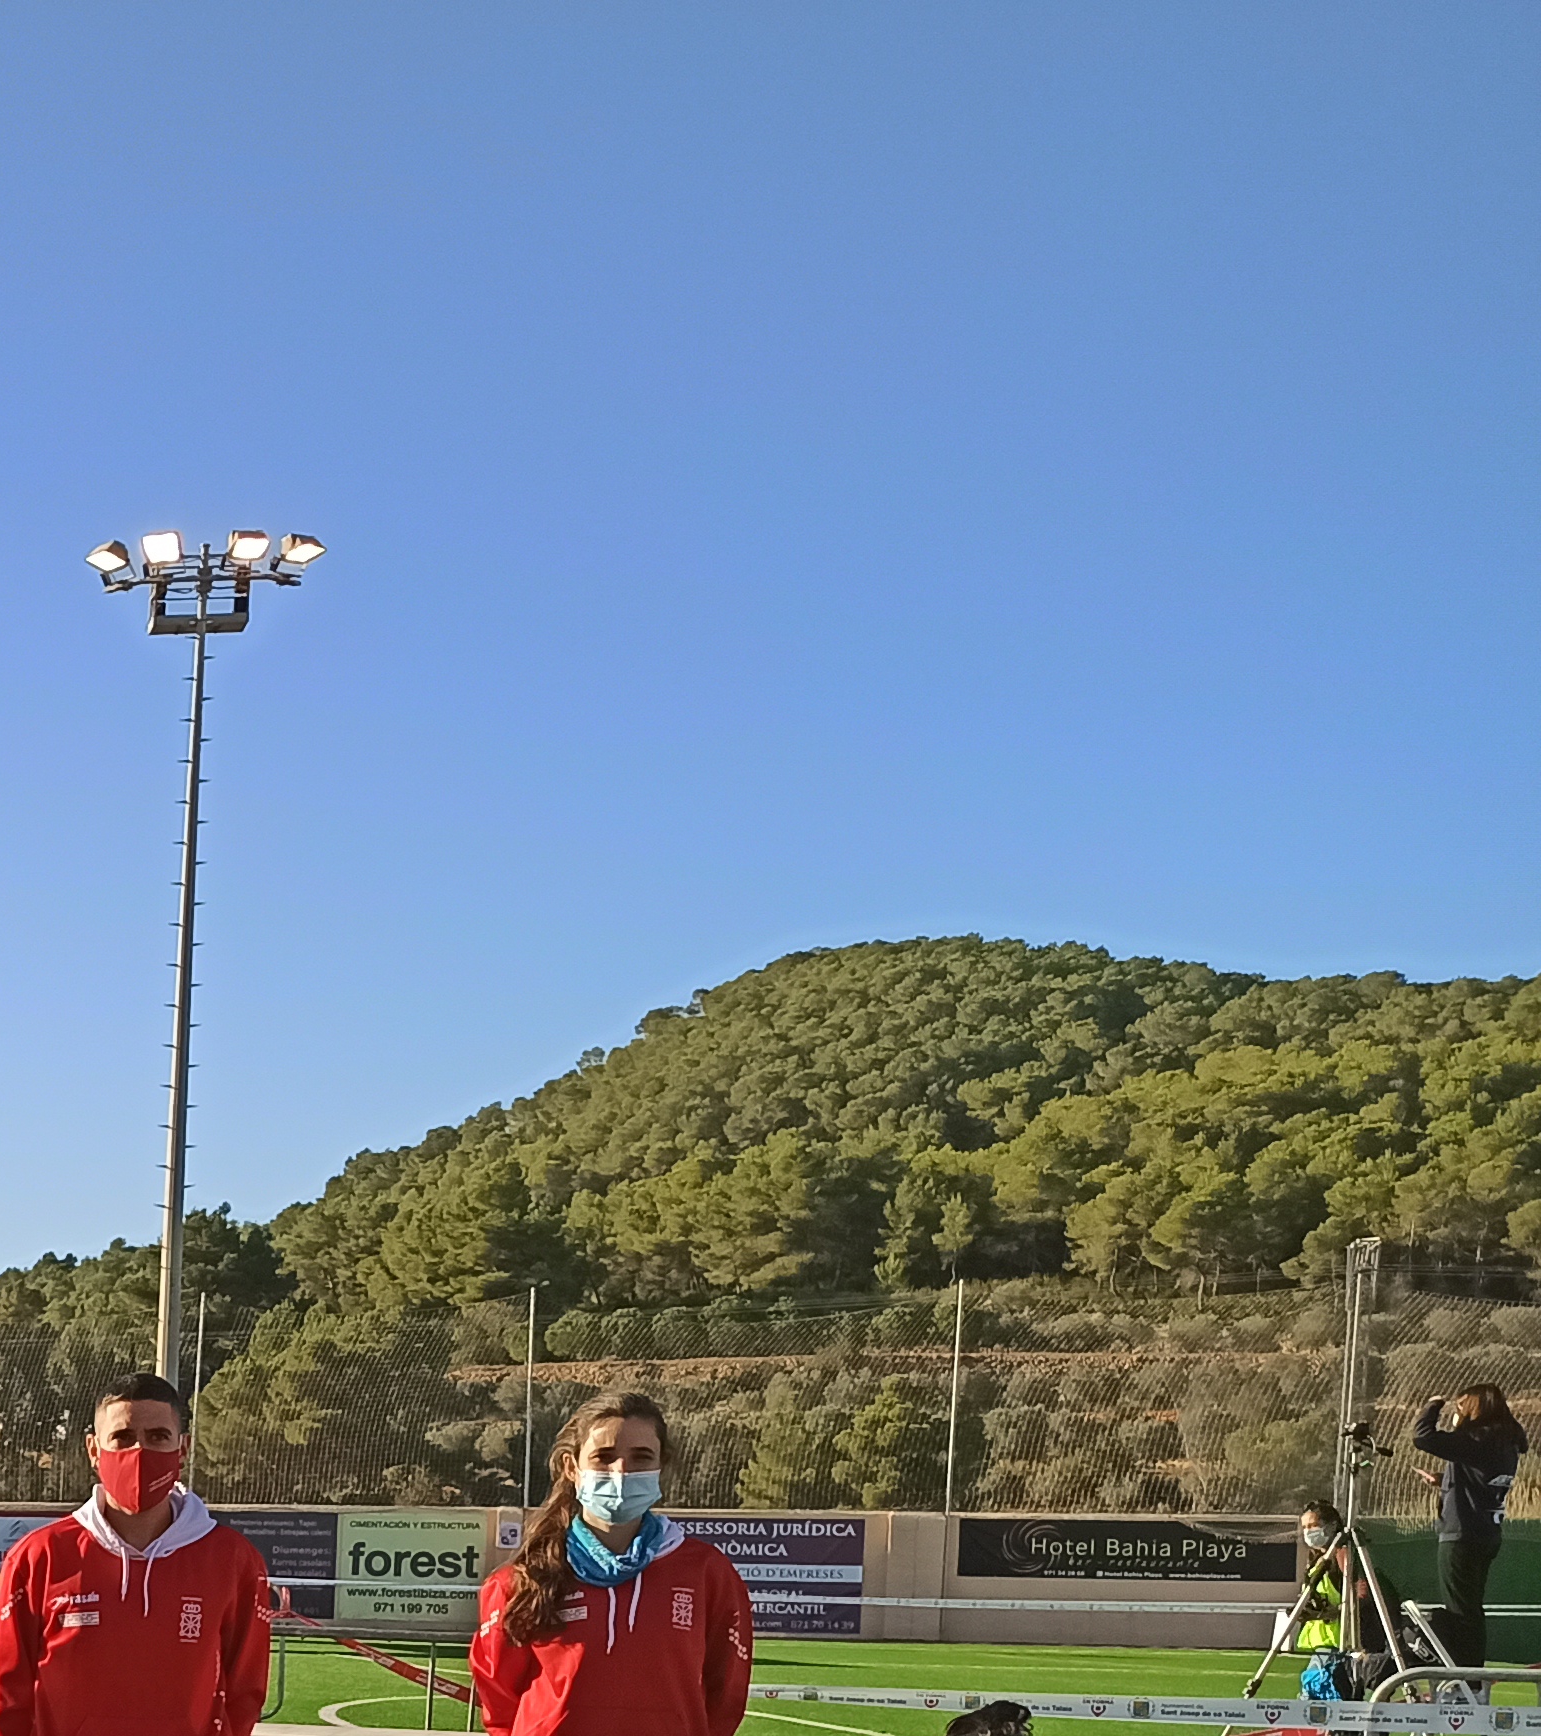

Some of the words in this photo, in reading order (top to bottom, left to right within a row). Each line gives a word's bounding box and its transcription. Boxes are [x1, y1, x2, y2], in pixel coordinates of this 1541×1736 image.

[349, 1520, 411, 1529] CIMENTACIÓN
[412, 1521, 420, 1529] Y
[420, 1521, 481, 1530] ESTRUCTURA
[771, 1520, 857, 1539] JURÍDICA
[1030, 1537, 1096, 1557] Hotel
[1105, 1537, 1172, 1557] Bahia
[1182, 1538, 1247, 1563] Playa
[347, 1541, 480, 1579] forest
[346, 1586, 478, 1600] www.forestibiza.com
[373, 1601, 395, 1613] 971
[399, 1602, 423, 1614] 199
[425, 1603, 449, 1615] 705
[750, 1602, 827, 1616] MERCANTIL
